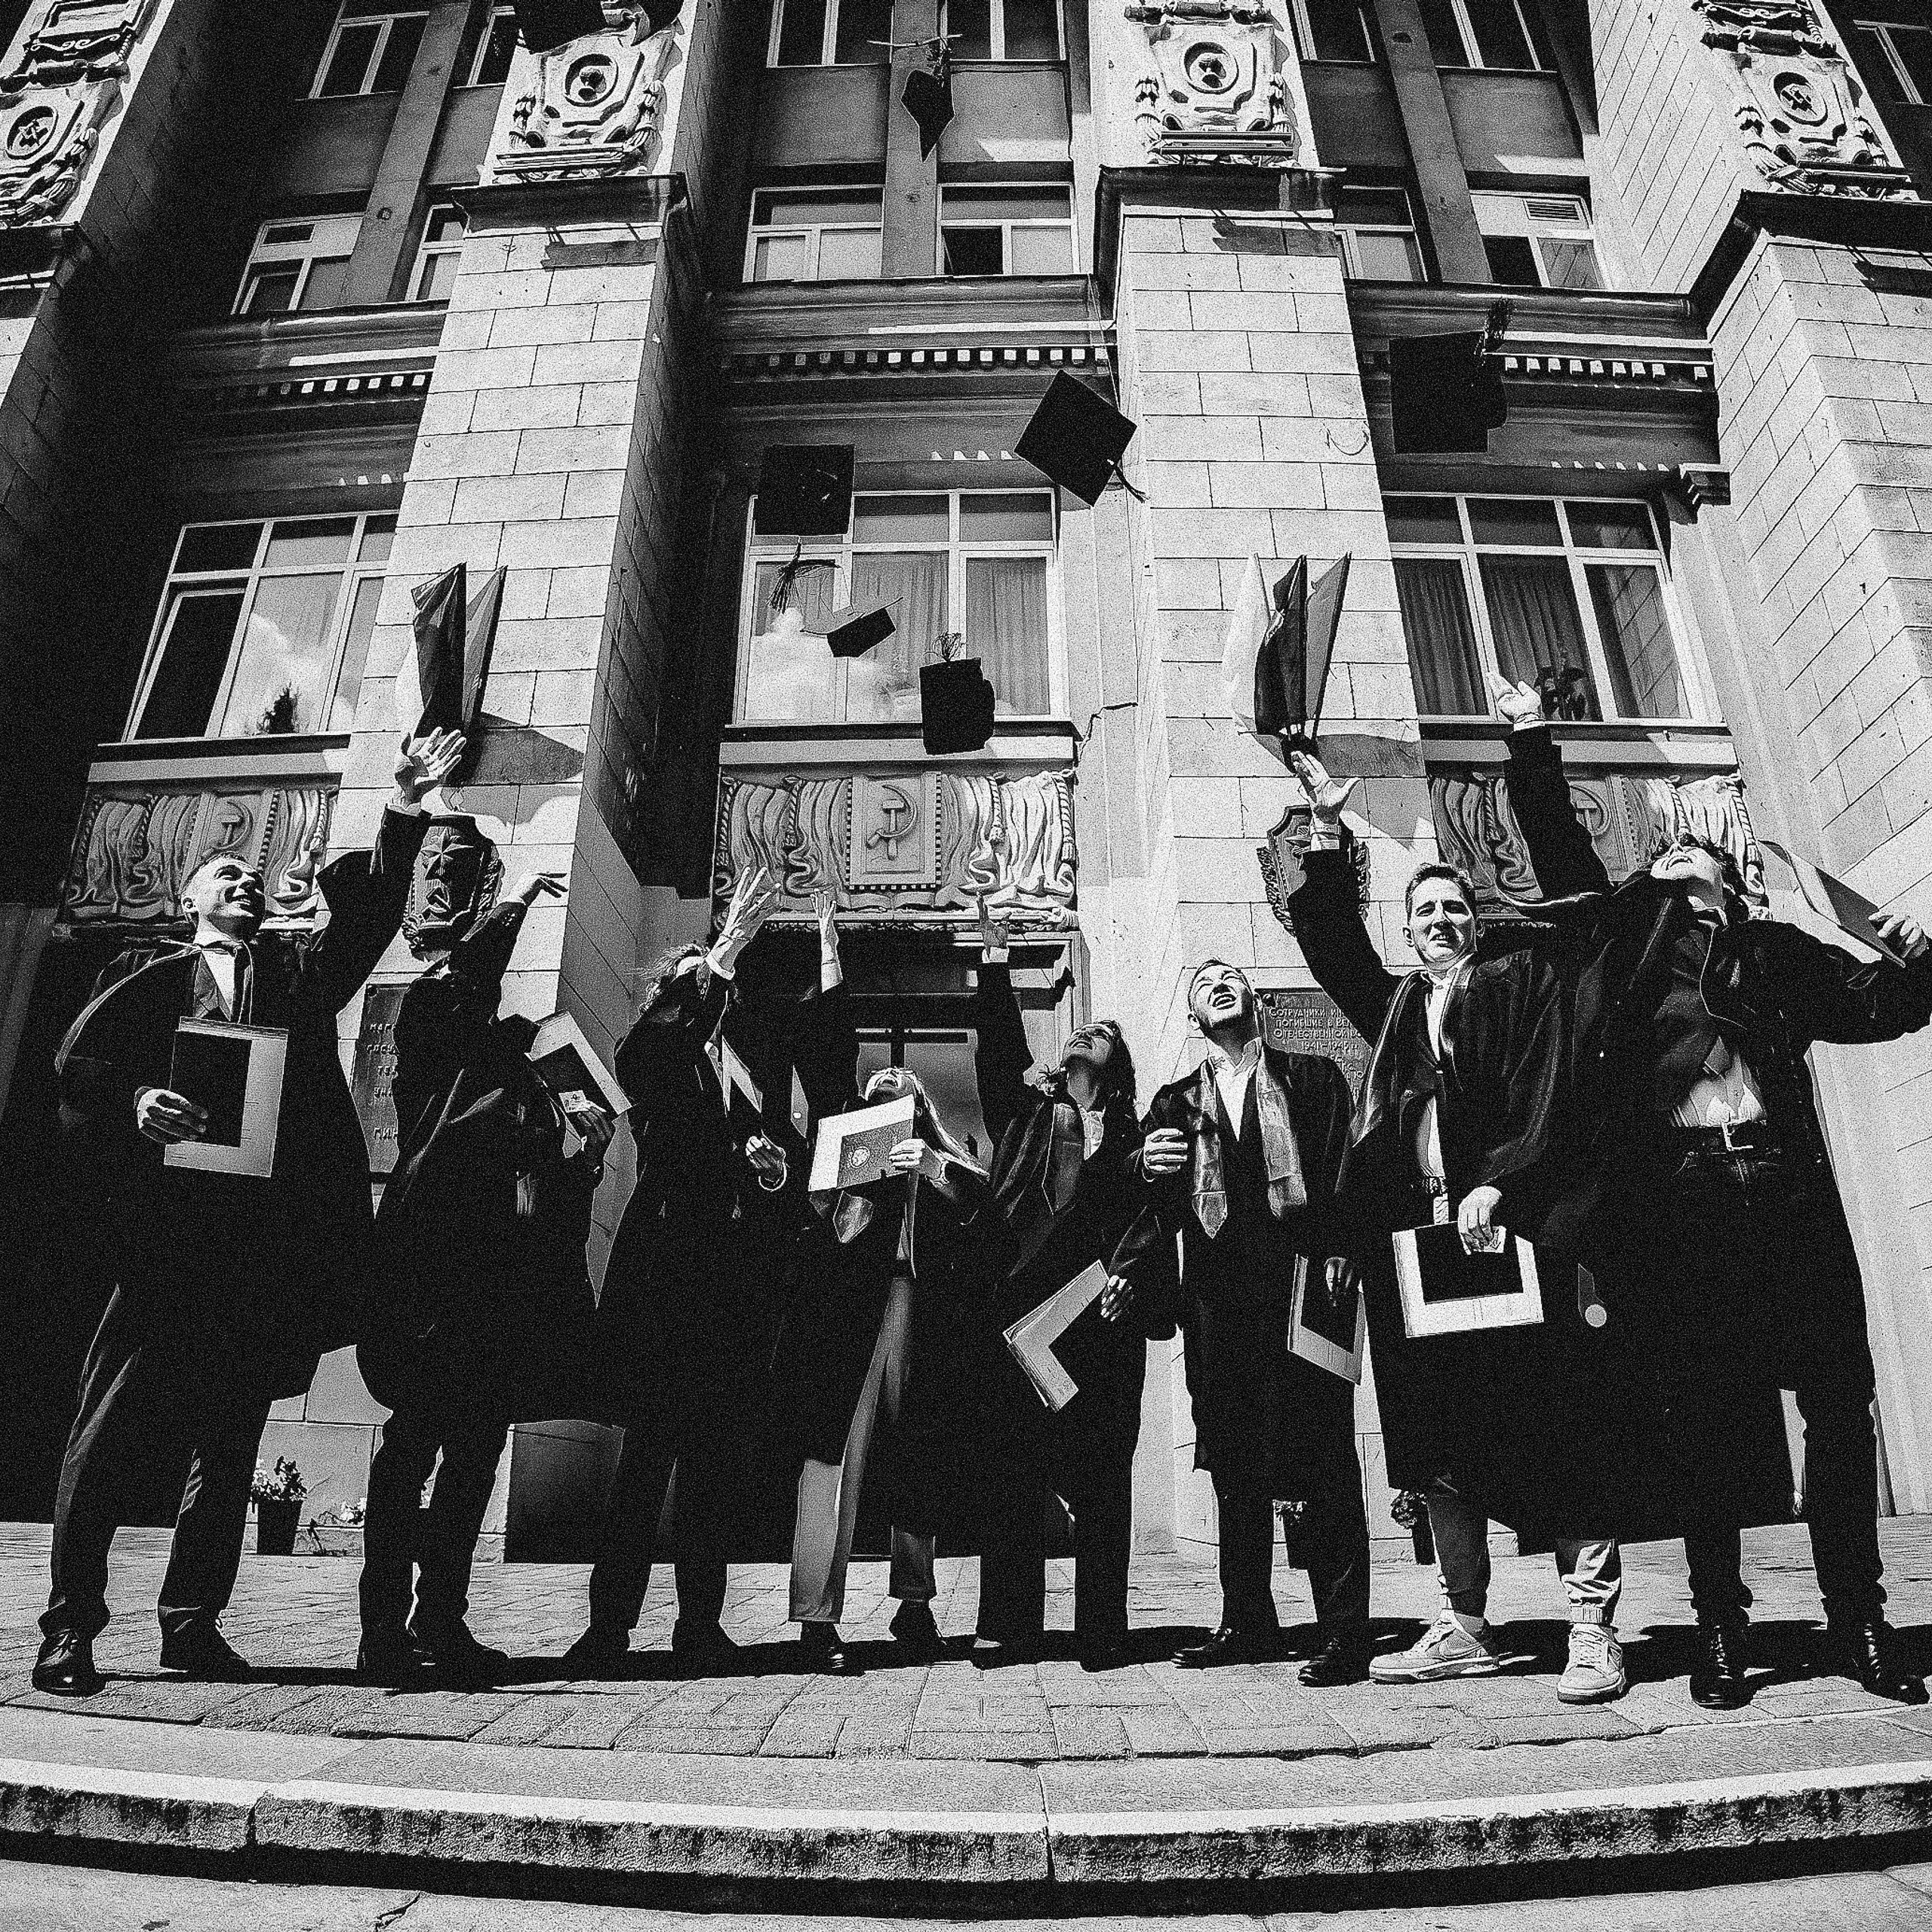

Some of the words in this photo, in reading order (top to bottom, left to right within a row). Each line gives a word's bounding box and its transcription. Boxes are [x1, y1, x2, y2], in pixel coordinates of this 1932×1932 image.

[1269, 1008, 1327, 1017] СОТРУДНИКИ
[1275, 1018, 1324, 1027] ПОГИБШИЕ
[369, 1023, 395, 1032] МАГ
[1273, 1028, 1349, 1038] ОТЕЧЕСТВЕННОЙ
